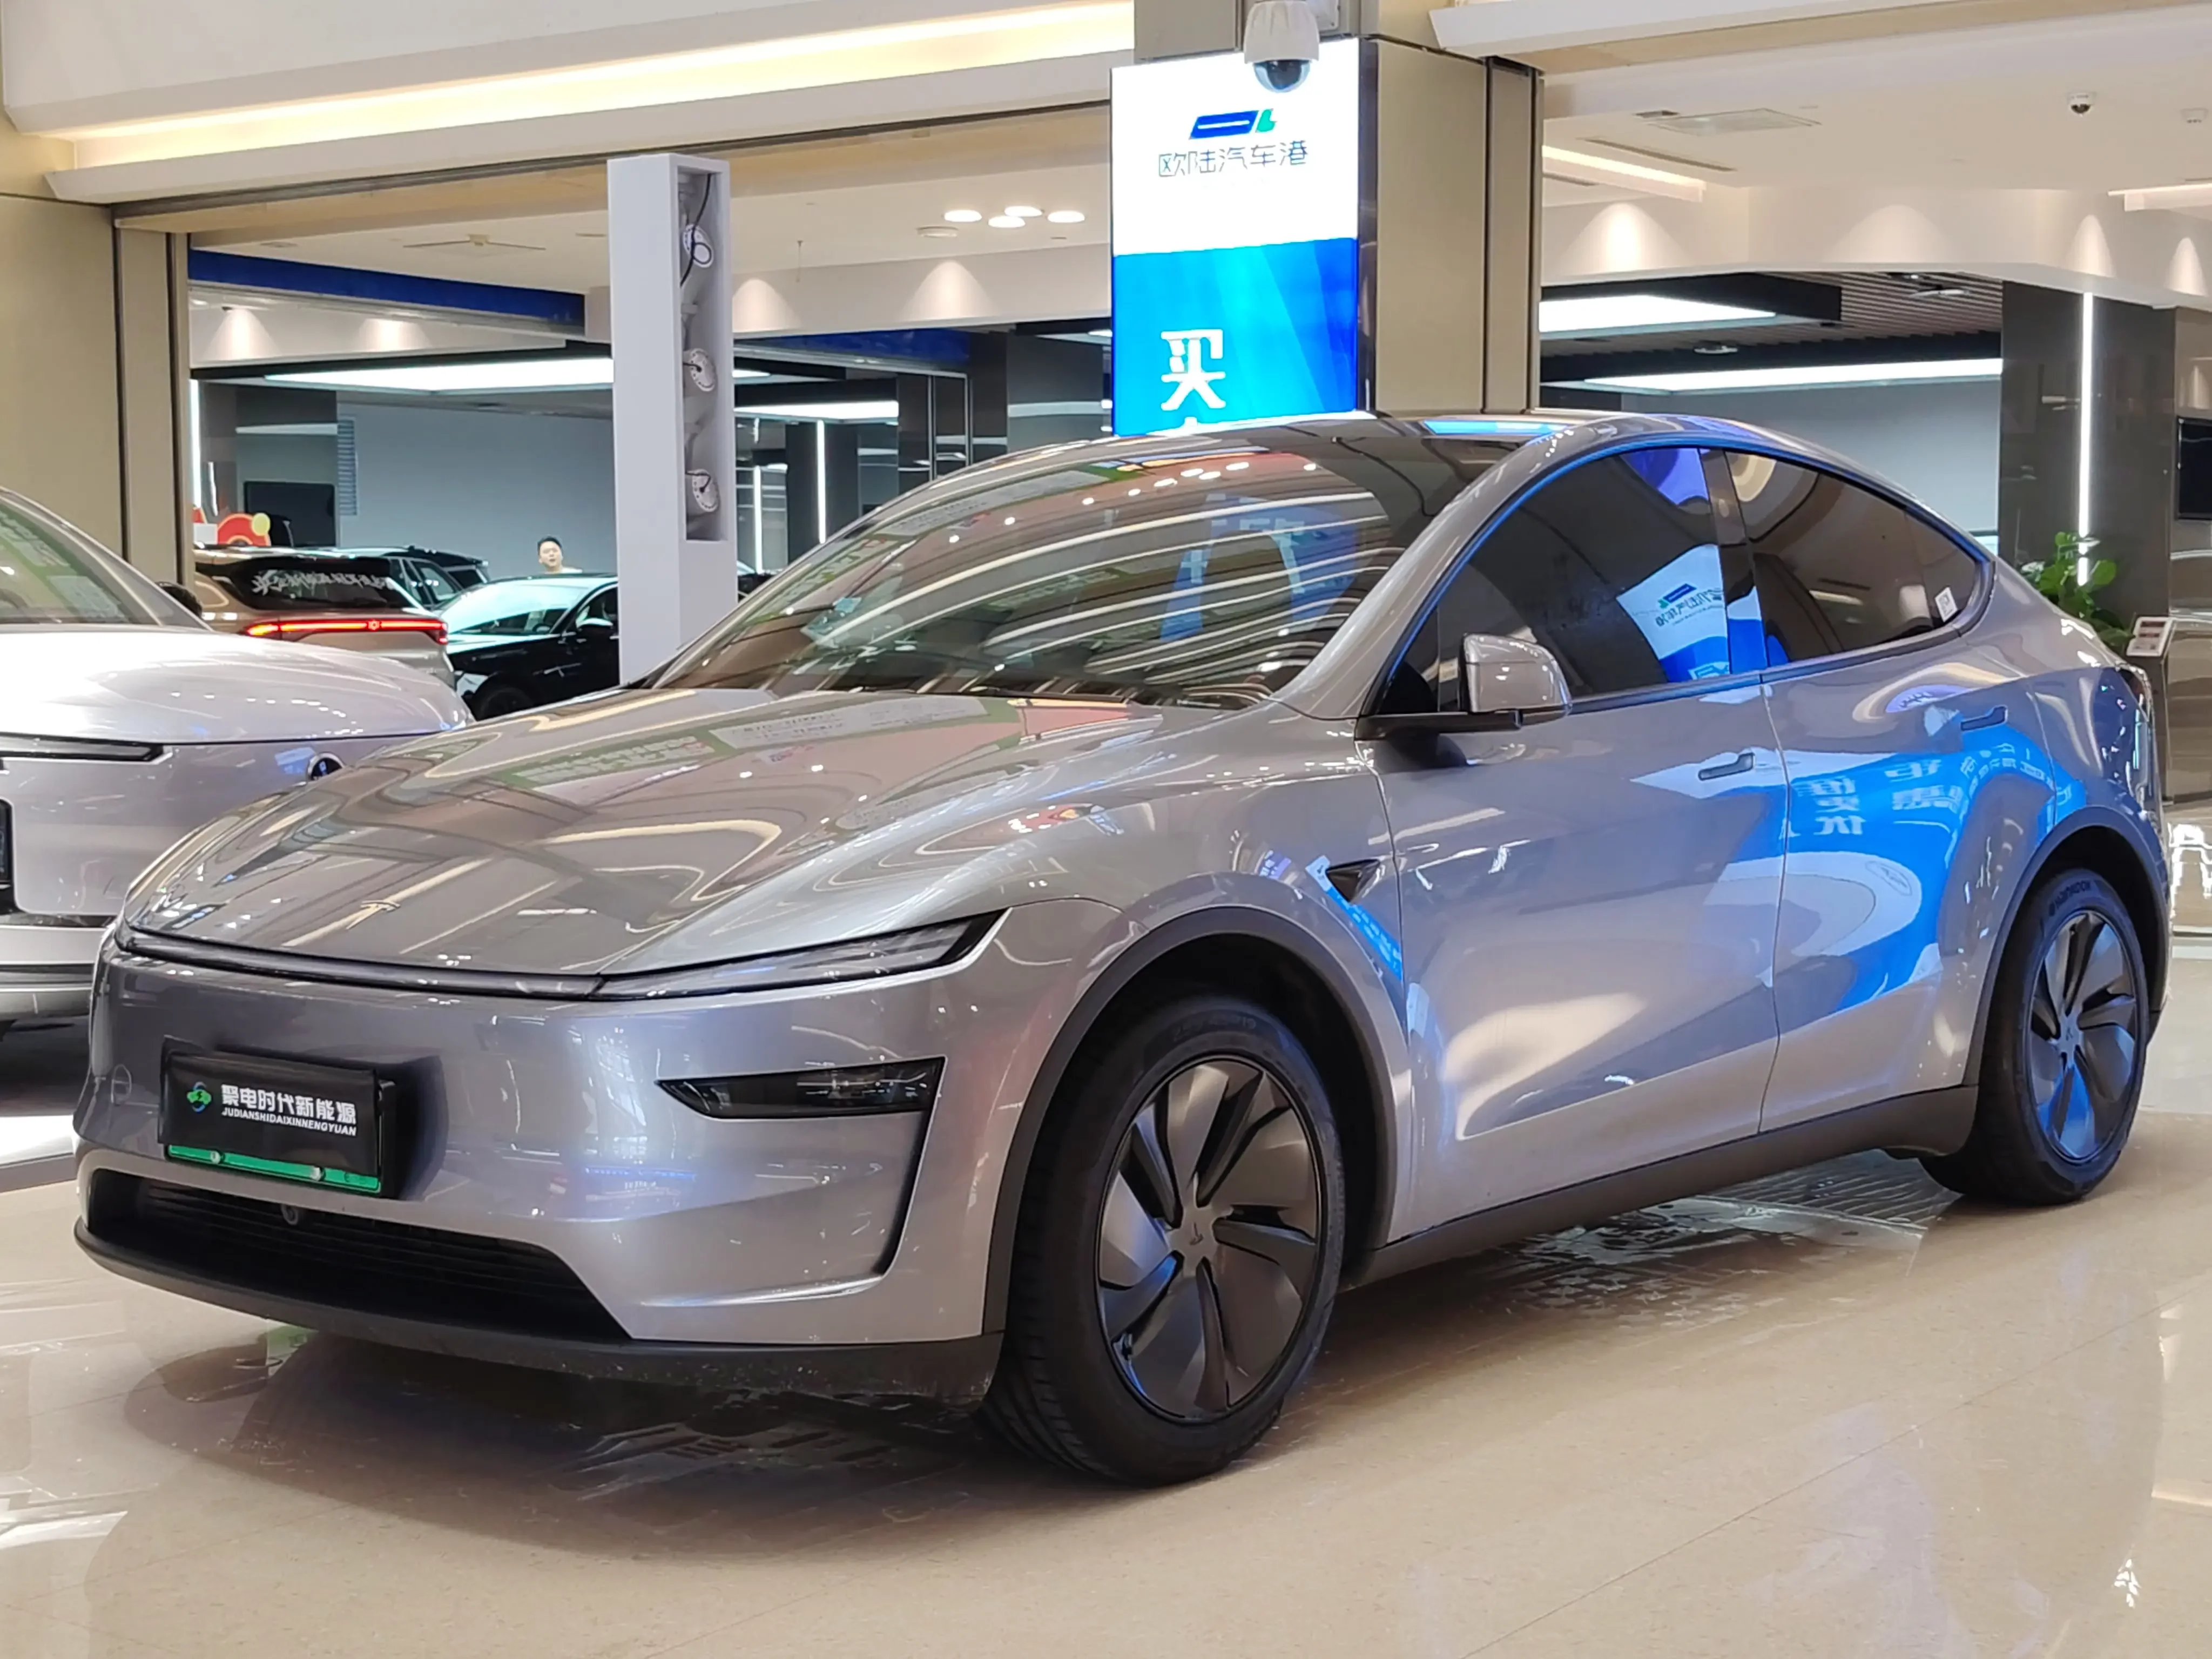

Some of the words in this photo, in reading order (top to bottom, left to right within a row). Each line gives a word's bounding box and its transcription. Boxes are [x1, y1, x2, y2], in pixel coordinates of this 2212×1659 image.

[1158, 140, 1309, 178] 欧陆汽车港
[1161, 328, 1226, 412] 买
[221, 1084, 356, 1124] 聚电时代新能源
[221, 1107, 357, 1137] JUDIANSHIDAIXINNENGYUAN
